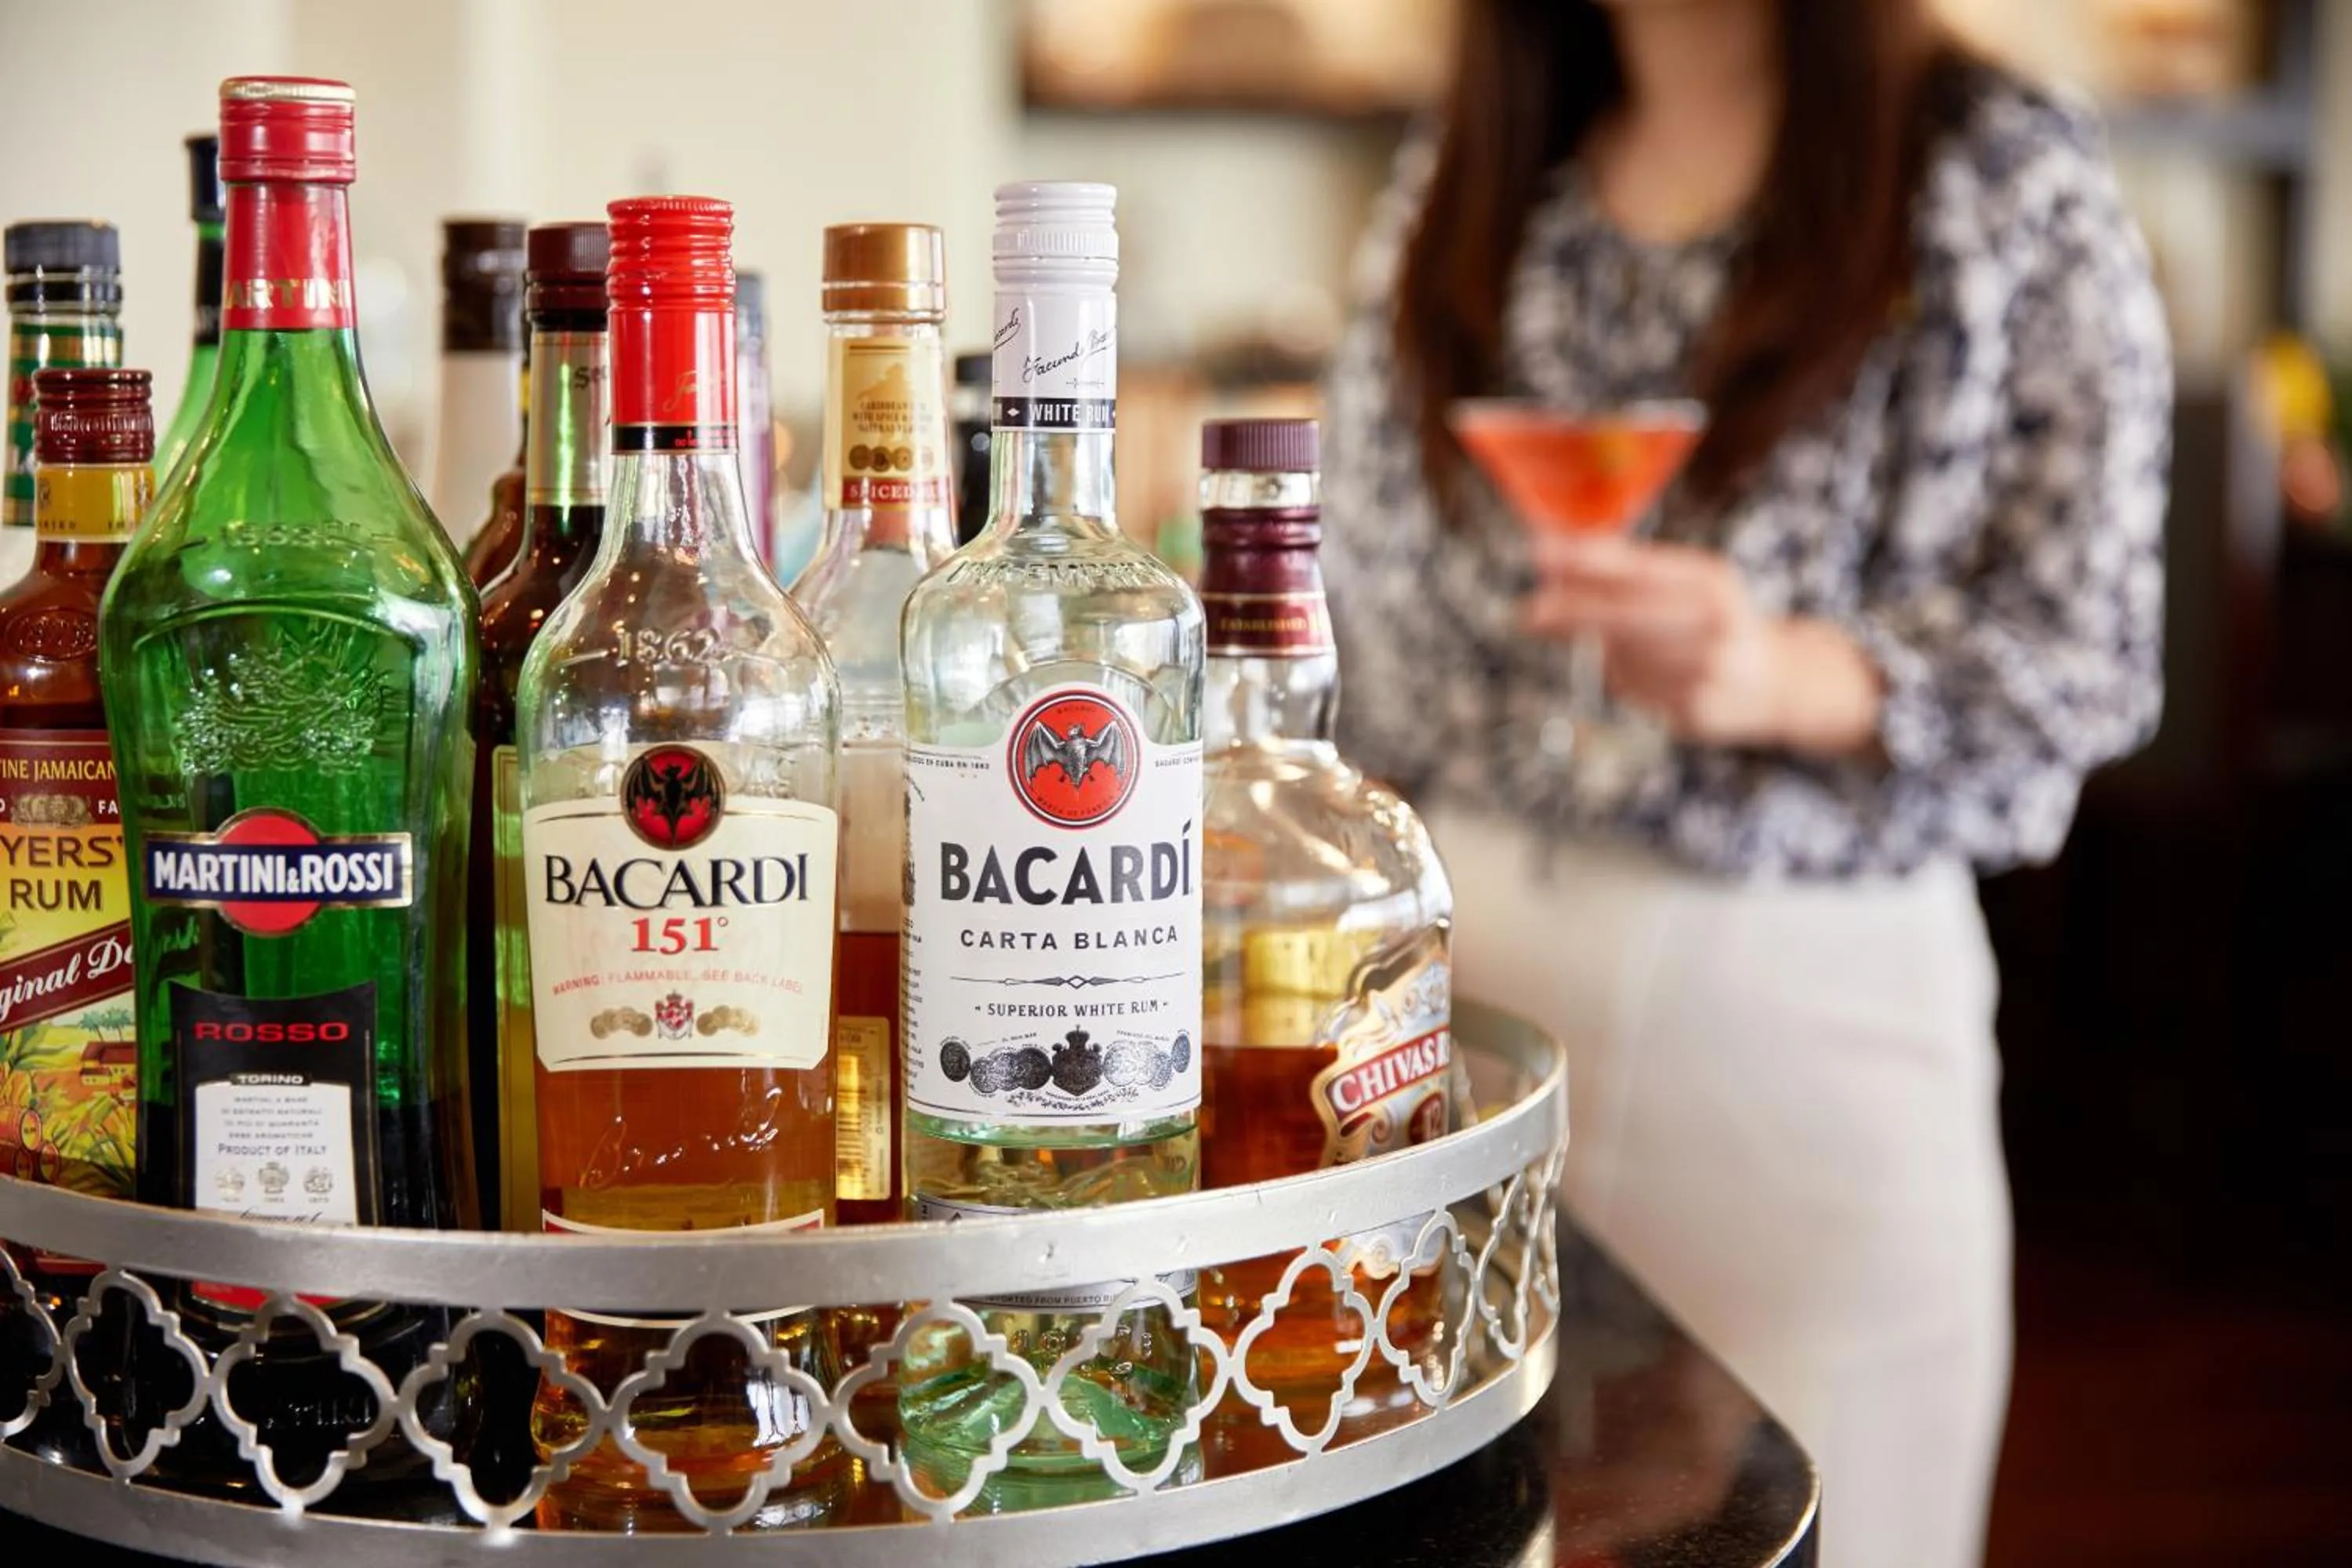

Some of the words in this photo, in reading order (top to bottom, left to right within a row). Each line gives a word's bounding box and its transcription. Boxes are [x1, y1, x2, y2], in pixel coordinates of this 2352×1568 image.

[1029, 404, 1081, 422] WHITE
[848, 483, 917, 501] SICED
[941, 820, 1192, 906] BACARDÍ
[544, 852, 810, 911] BACARDI
[10, 878, 103, 911] RUM
[960, 928, 1058, 950] CARTA
[1074, 925, 1178, 950] BLANCA
[700, 968, 729, 982] SEE
[733, 971, 769, 987] BACK
[988, 1003, 1069, 1017] SUPERIOR
[1075, 1002, 1125, 1017] WHITE
[1129, 1000, 1160, 1014] RUM
[194, 1022, 349, 1042] ROSSO
[238, 1074, 303, 1085] TORINO
[1332, 1036, 1436, 1112] CHIVAS
[295, 1144, 327, 1156] ITALY
